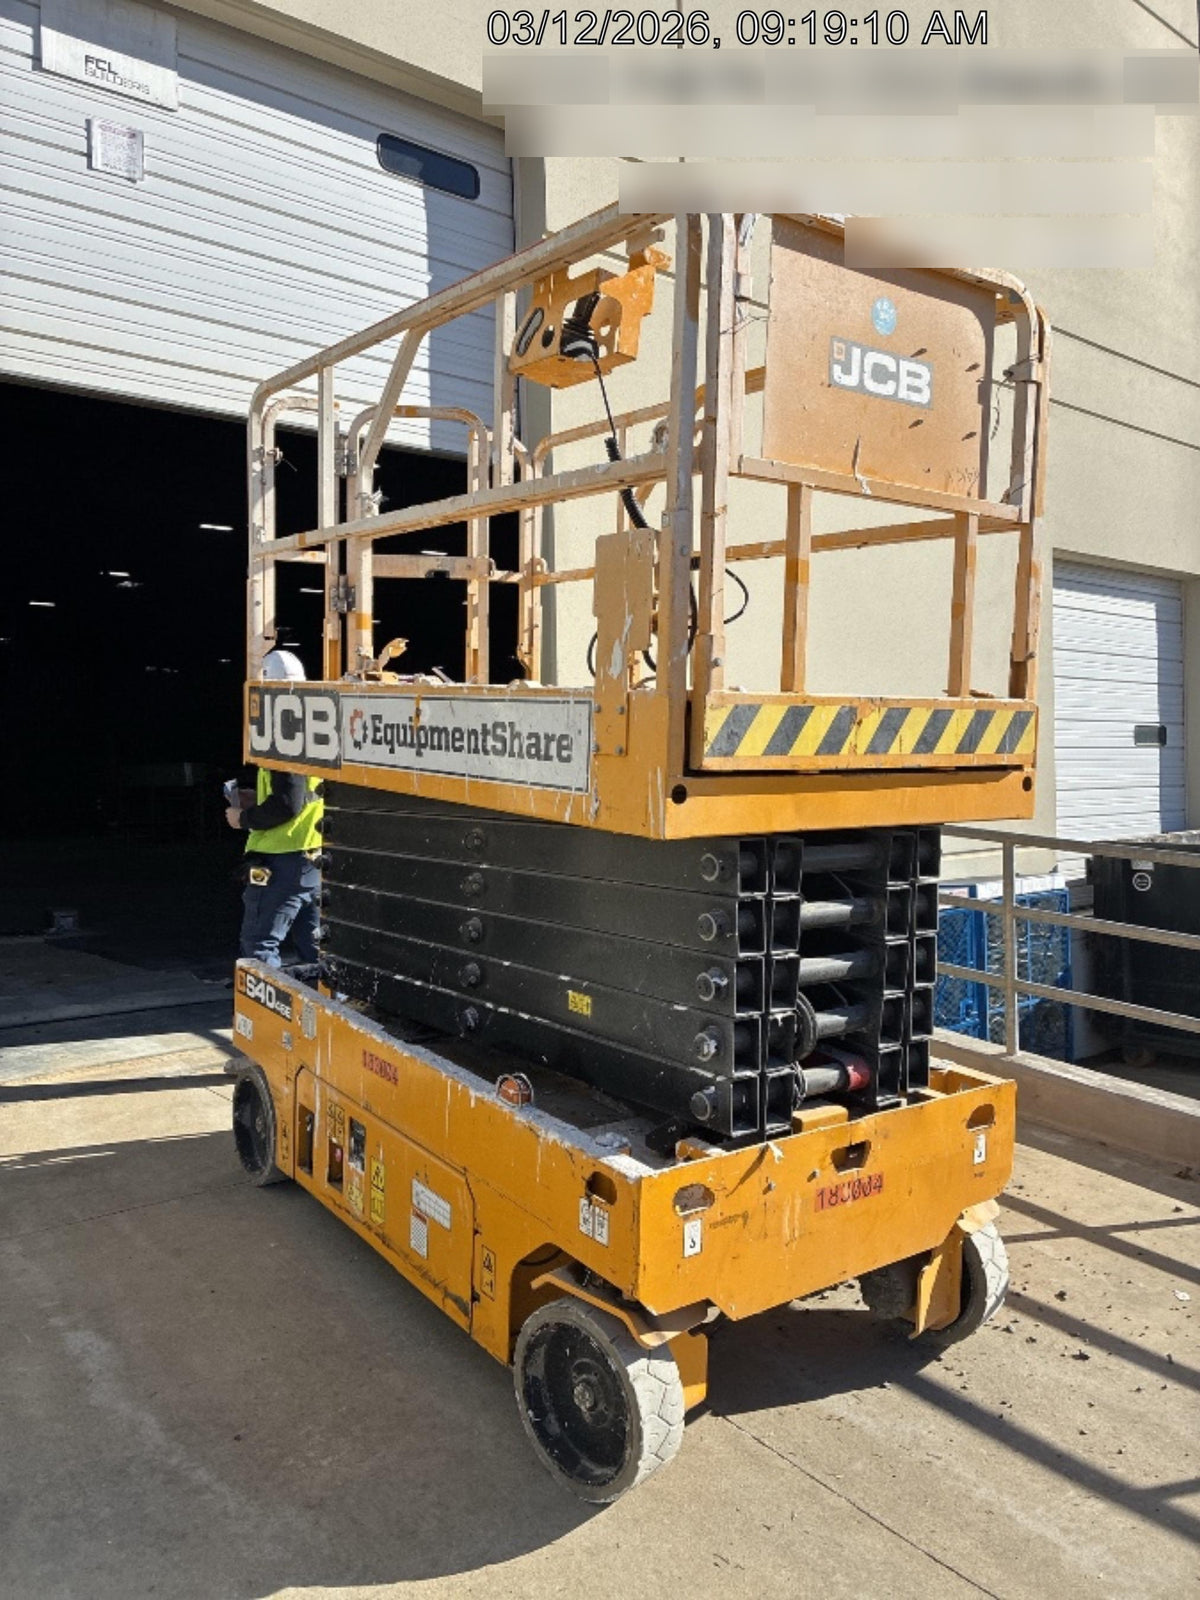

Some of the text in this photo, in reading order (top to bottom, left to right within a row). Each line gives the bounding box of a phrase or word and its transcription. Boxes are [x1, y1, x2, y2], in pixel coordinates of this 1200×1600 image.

[84, 54, 118, 76] FCL
[832, 346, 931, 404] JCB
[250, 694, 339, 760] JCB
[370, 714, 574, 764] EquipmentShare
